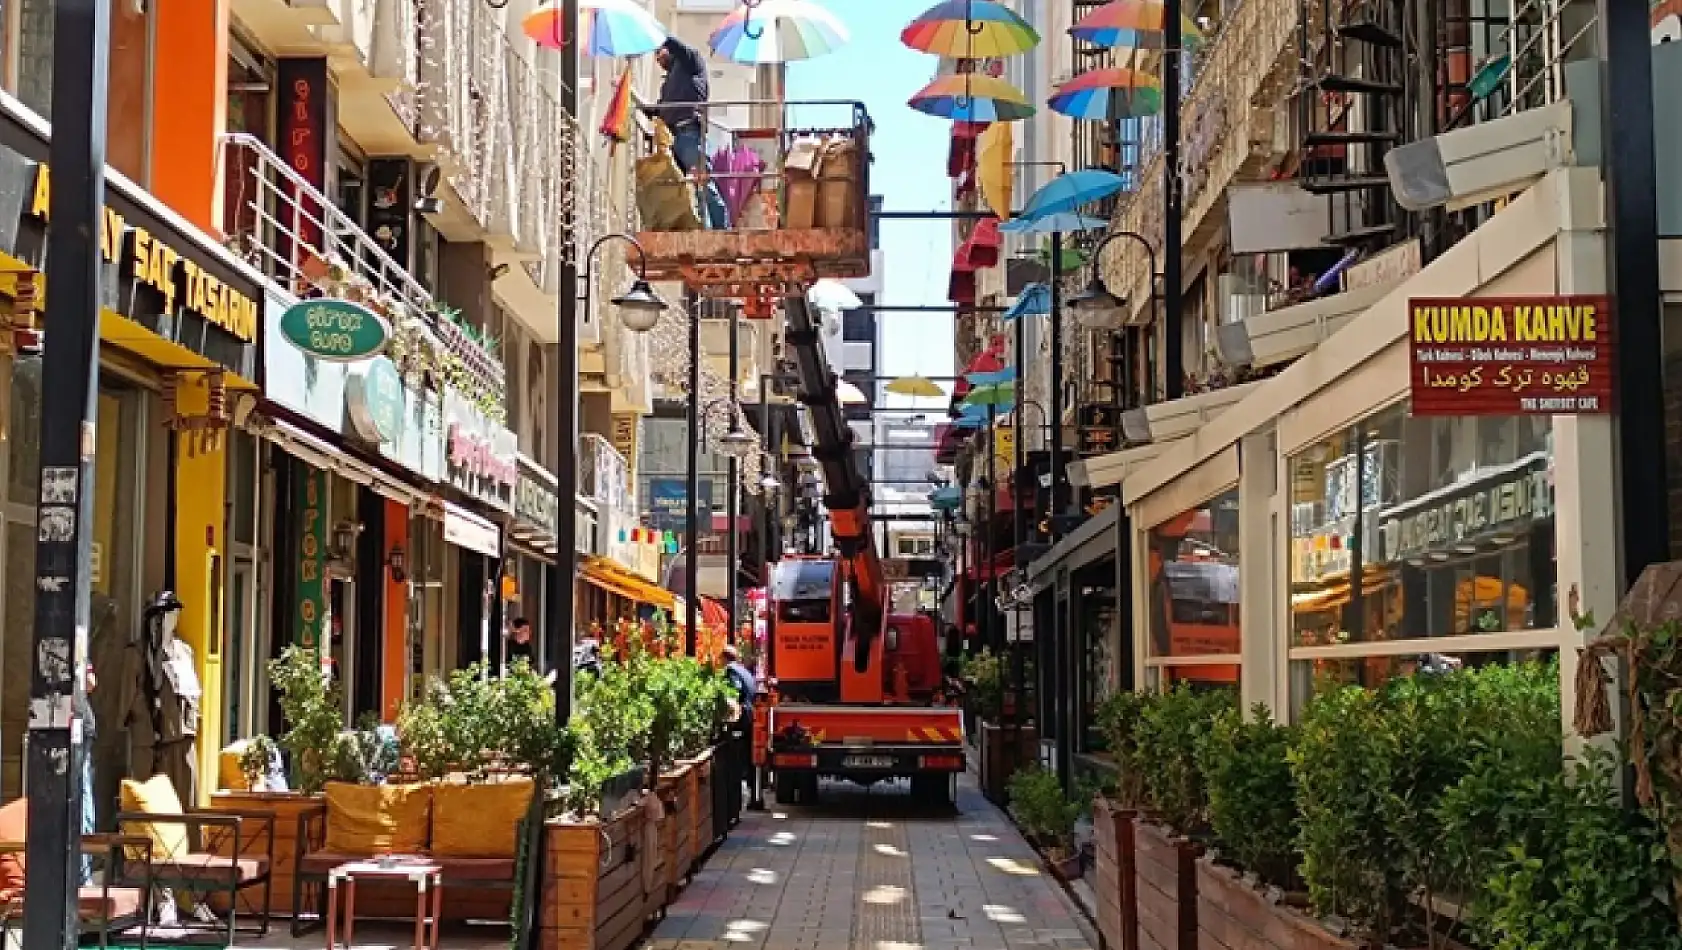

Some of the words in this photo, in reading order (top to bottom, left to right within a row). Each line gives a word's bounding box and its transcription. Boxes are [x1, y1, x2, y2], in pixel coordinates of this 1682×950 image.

[135, 226, 177, 315] SAÇ
[183, 257, 258, 344] TASARIM
[1414, 306, 1508, 343] KUMDA
[1513, 306, 1597, 342] KAHVE
